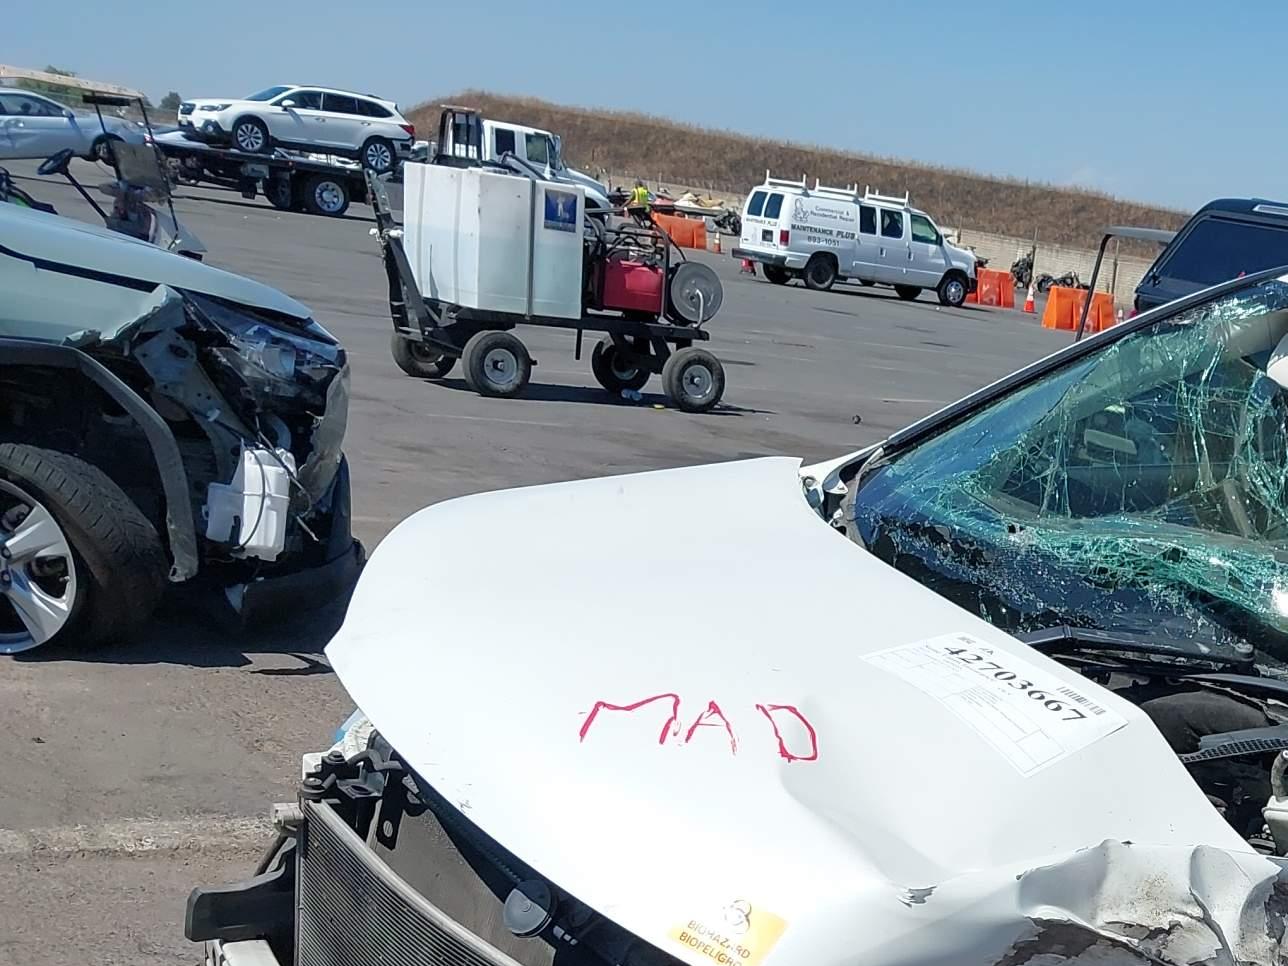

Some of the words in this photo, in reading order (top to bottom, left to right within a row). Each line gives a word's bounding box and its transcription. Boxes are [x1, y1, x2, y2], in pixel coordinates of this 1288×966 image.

[791, 223, 834, 236] MAINTENANCE
[835, 230, 856, 241] PLUS
[943, 645, 1089, 722] 42703667
[578, 693, 818, 763] MAD
